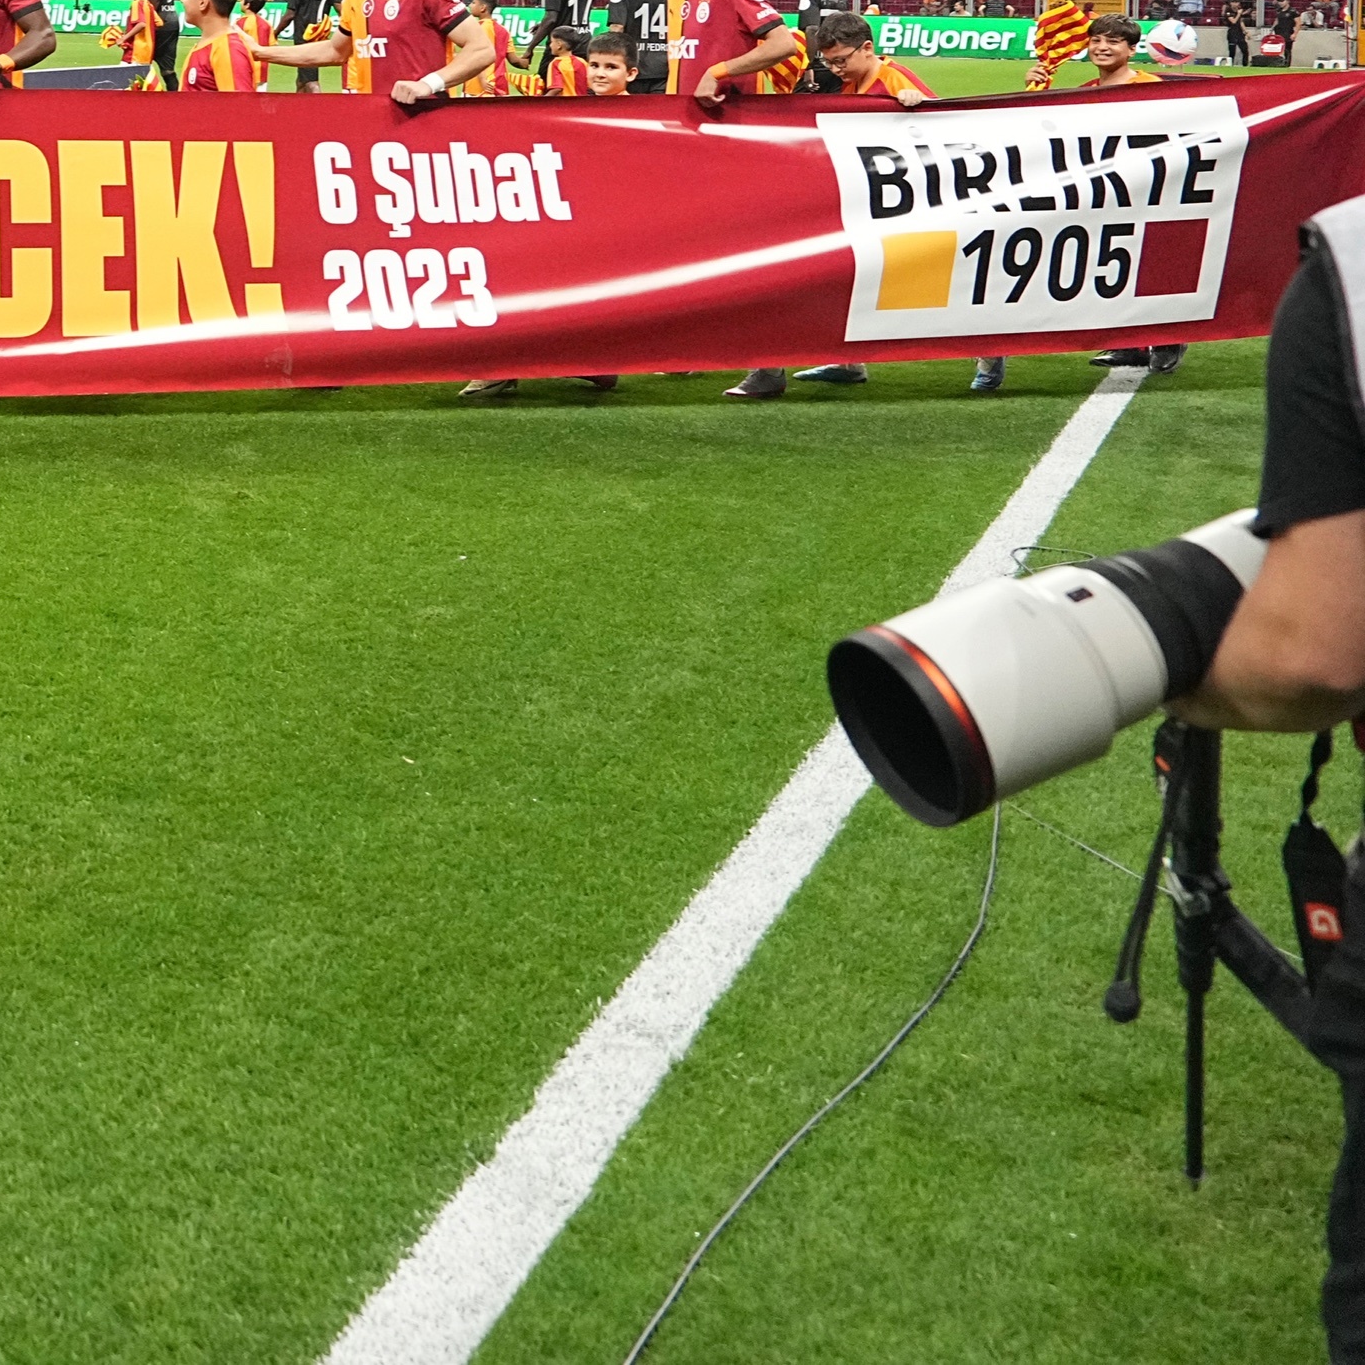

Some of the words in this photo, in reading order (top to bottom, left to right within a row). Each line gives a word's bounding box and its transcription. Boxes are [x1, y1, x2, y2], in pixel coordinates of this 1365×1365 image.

[634, 3, 668, 40] 14
[878, 16, 1016, 58] Bilyoner
[312, 141, 357, 226] 6
[371, 141, 574, 239] Şubat
[321, 246, 499, 332] 2023
[961, 222, 1136, 305] 1905
